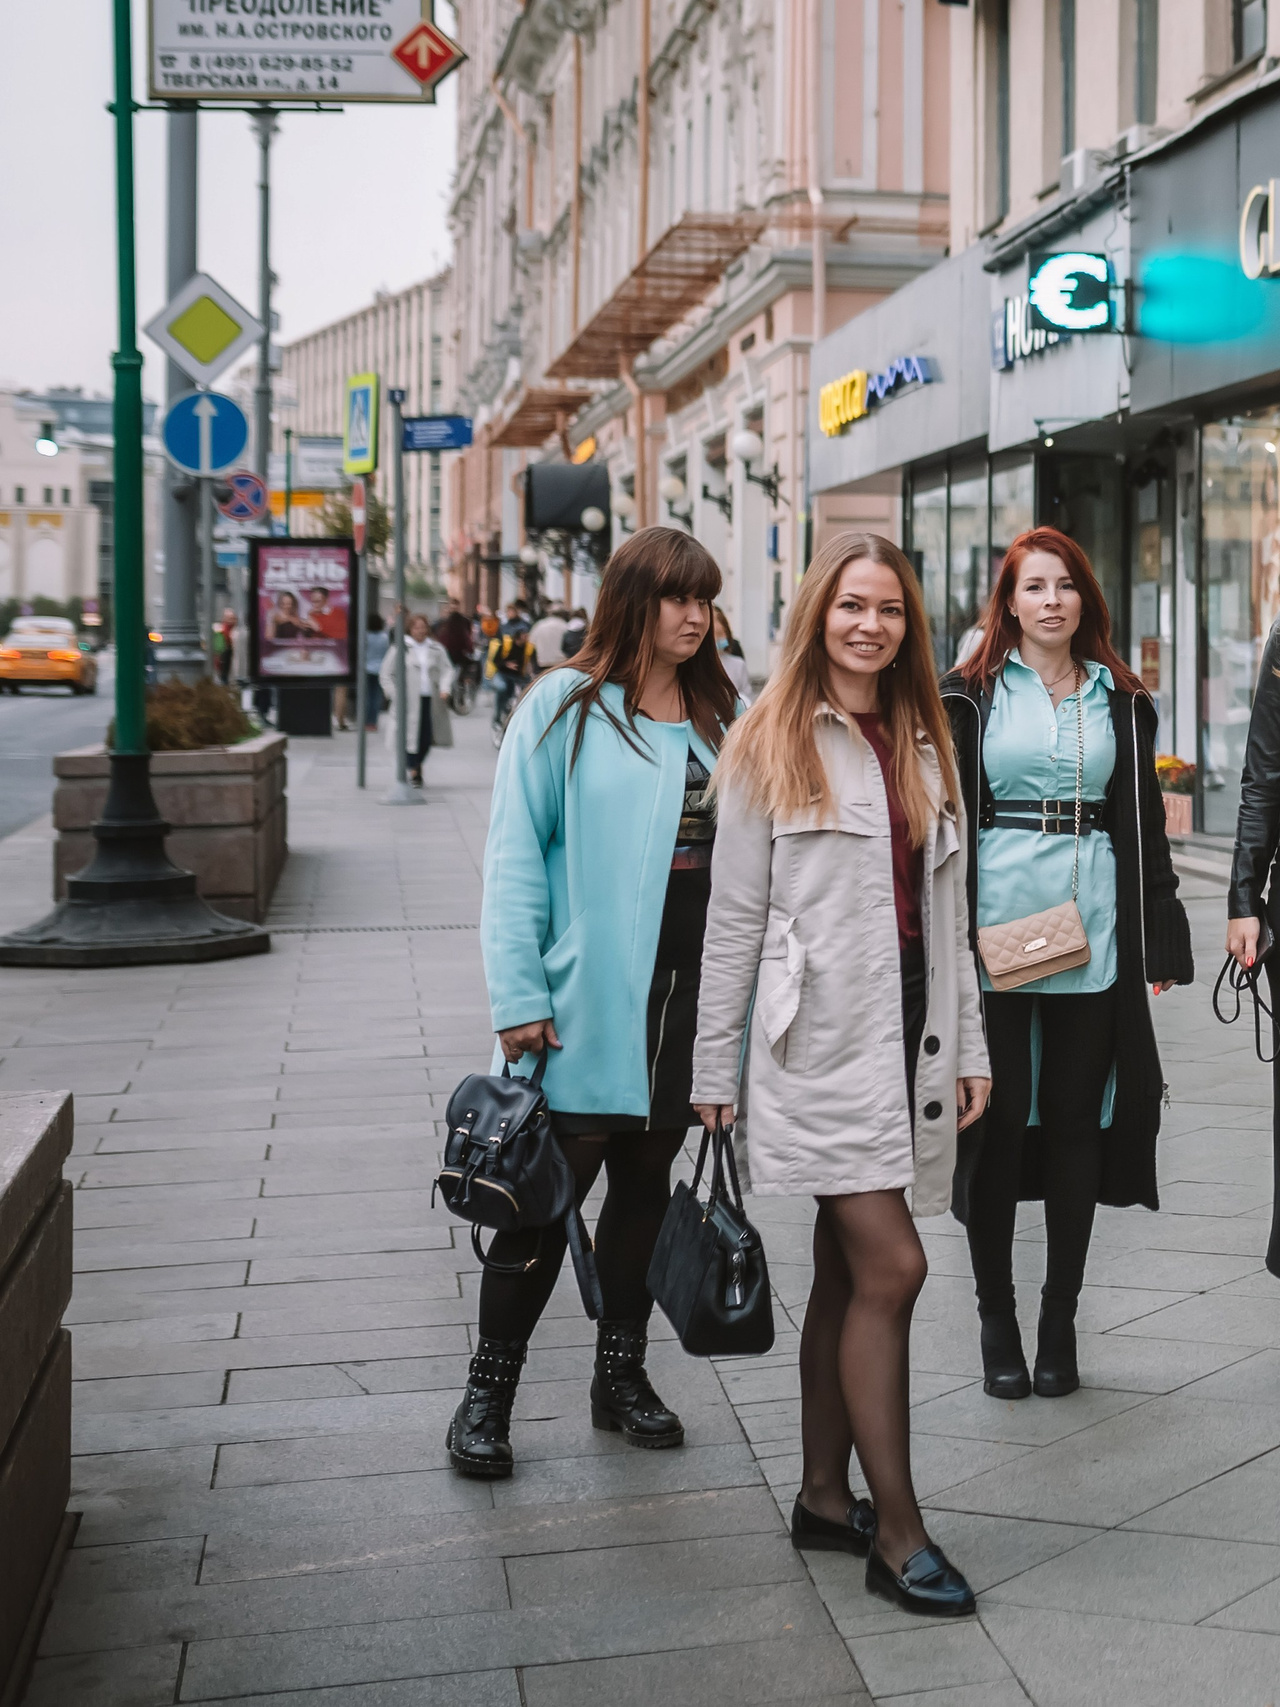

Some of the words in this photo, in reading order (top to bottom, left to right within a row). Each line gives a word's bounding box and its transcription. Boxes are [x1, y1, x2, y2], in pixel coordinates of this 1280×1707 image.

[189, 55, 201, 70] 8
[161, 72, 258, 88] ТВЕРСКАЯ
[316, 75, 339, 90] 14
